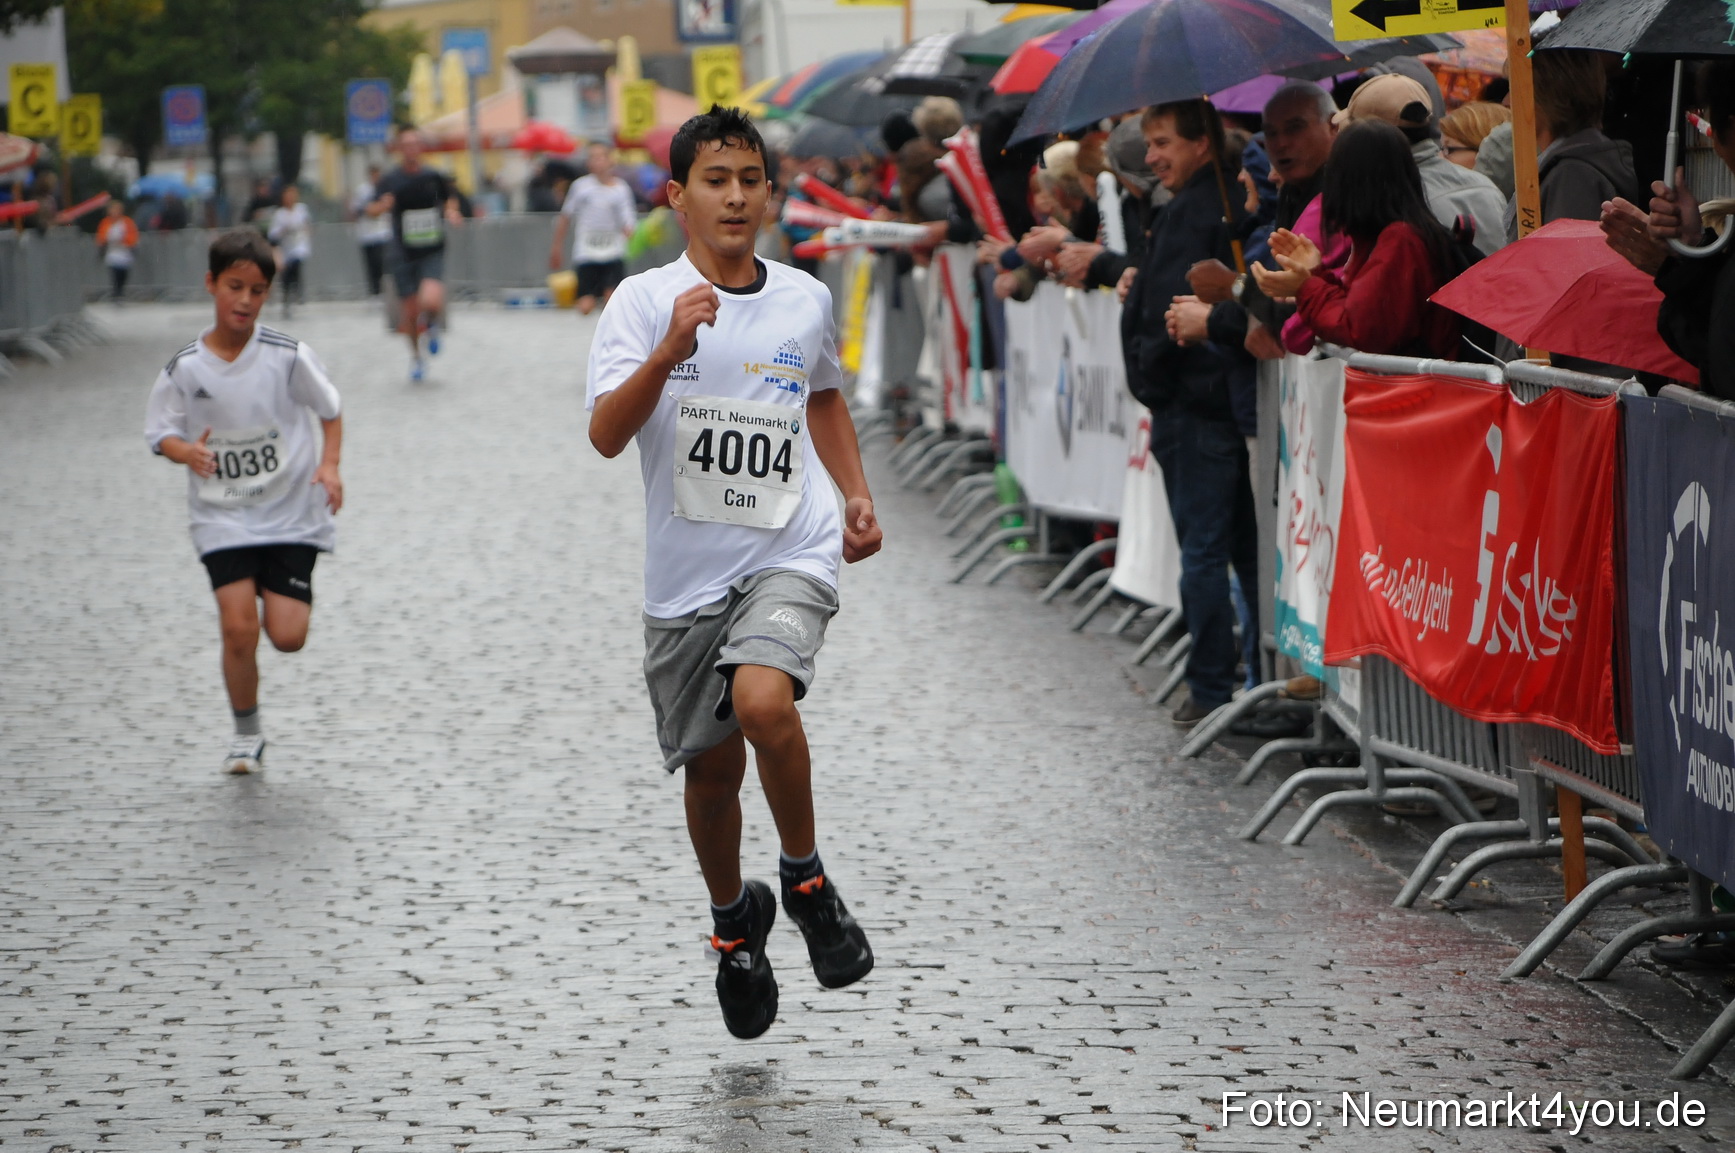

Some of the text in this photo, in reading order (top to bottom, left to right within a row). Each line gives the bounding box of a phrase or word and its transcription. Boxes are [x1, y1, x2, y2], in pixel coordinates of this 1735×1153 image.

[705, 66, 730, 101] C
[21, 84, 46, 118] C
[671, 362, 700, 374] RTL
[743, 362, 762, 374] 14.
[680, 406, 788, 430] PARTL Neumarkt
[688, 428, 792, 483] 4004
[724, 488, 756, 509] Can
[1417, 566, 1453, 641] geht
